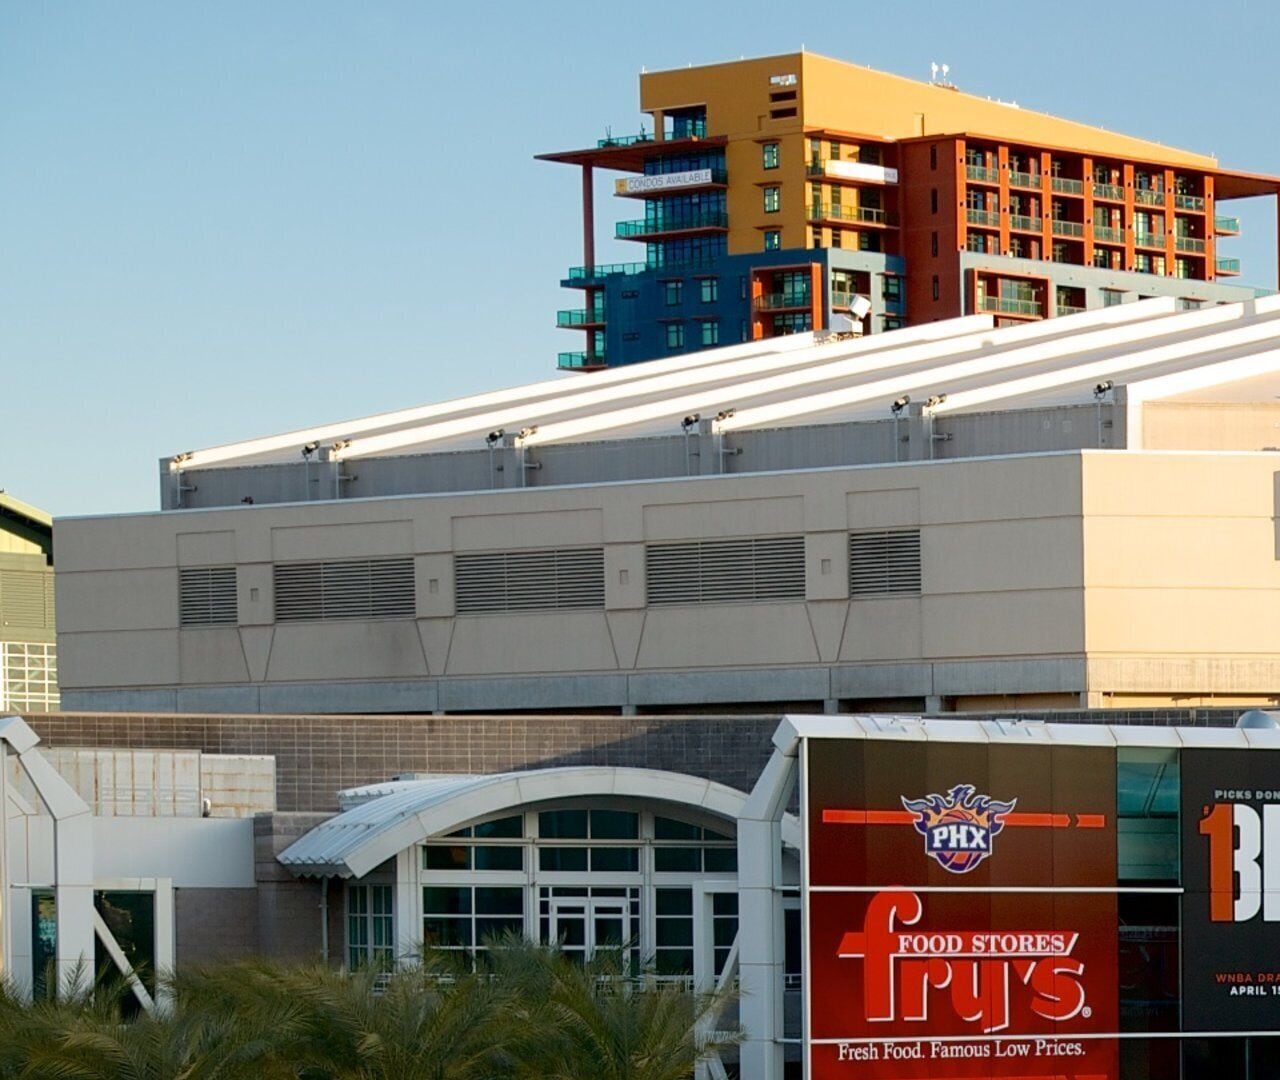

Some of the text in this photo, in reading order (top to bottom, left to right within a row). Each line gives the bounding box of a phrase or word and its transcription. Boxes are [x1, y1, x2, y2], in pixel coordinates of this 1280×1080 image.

[629, 170, 711, 190] CONDOS AVAILABLE
[1214, 790, 1252, 800] PICKS
[932, 825, 989, 850] PHX
[898, 935, 1065, 953] FOOD STORES
[836, 885, 1085, 1034] fry's
[1216, 974, 1252, 983] WNBA
[1230, 986, 1267, 995] APRIL
[838, 1039, 1086, 1060] Fresh Food. Famous Low Prices.
